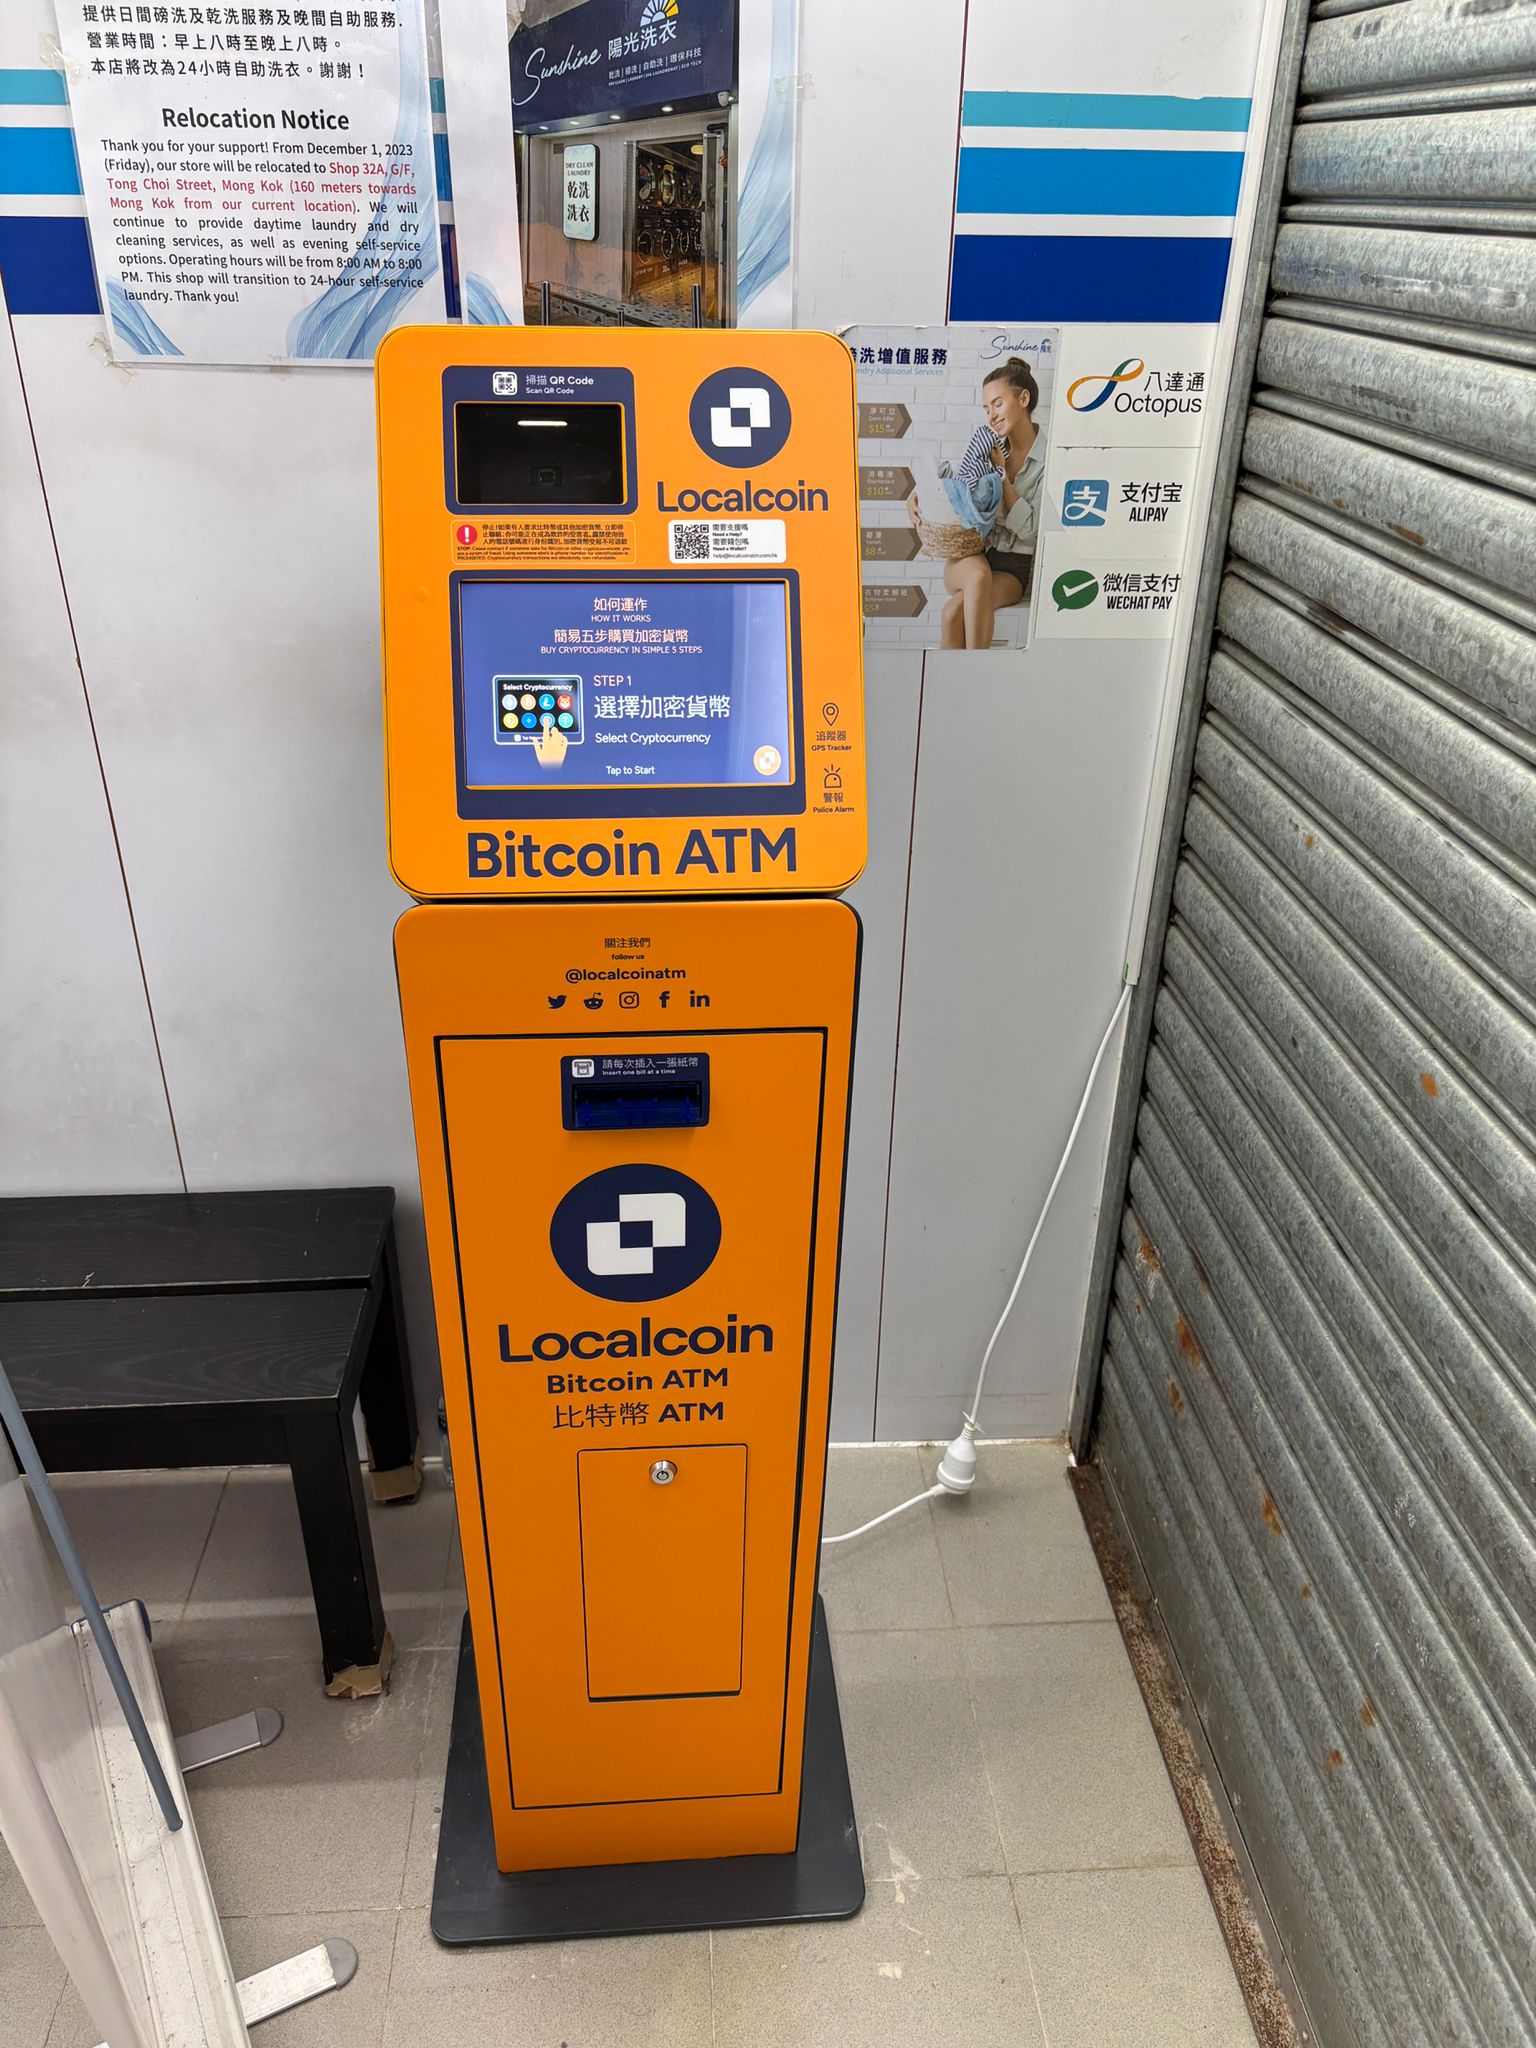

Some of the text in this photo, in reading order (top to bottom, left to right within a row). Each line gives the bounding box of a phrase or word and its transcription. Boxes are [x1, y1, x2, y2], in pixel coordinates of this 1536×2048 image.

[608, 19, 678, 61] 陽光洗衣
[512, 44, 602, 106] Sunshine
[162, 107, 350, 130] Relocation Notice
[101, 139, 413, 157] Thank you for your support! From December 1, 2023
[104, 158, 415, 177] (Friday), our store will be relocated to Shop 32A, G/F,
[567, 169, 591, 177] LAUNDRY
[106, 178, 416, 195] Tong Choi Street, Mong Kok (160 meters towards
[567, 181, 590, 199] 乾洗
[110, 197, 418, 214] Mong Kok from our current location). We will
[567, 203, 591, 222] 洗衣
[113, 216, 419, 235] continue to provide daytime laundry and dry
[115, 234, 421, 252] cleaning services, as well as evening self-service
[118, 253, 422, 270] options. Operating hours will be from 8:00 AM to 8:00
[121, 271, 424, 288] PM. This shop will transition to 24-hour self-service
[124, 289, 239, 304] laundry. Thank you!
[980, 335, 1039, 359] Sunshine
[525, 374, 594, 386] 掃描 QR Code
[914, 368, 944, 376] Services
[1144, 371, 1205, 392] 八達通
[1114, 392, 1202, 417] Octopus
[657, 480, 829, 512] Localcoin
[1119, 482, 1183, 504] 支付宝
[1129, 507, 1169, 522] ALIPAY
[1102, 573, 1181, 593] 微信支付
[593, 597, 648, 612] 如何運作
[1106, 596, 1173, 610] WECHAT PAY
[554, 628, 689, 643] 簡易五步購買加密貨幣
[593, 675, 632, 687] STEP 1
[594, 695, 730, 719] 選擇加密貨幣
[595, 733, 711, 745] Select Cryptocurrency
[606, 766, 655, 776] Tap to Start
[467, 827, 797, 878] Bitcoin ATM
[604, 937, 651, 949] 關注我們
[565, 967, 686, 984] @localcoinatm
[498, 1314, 774, 1363] Localcoin
[547, 1368, 728, 1394] Bitcoin ATM
[552, 1401, 724, 1429] 比特幣 ATM
